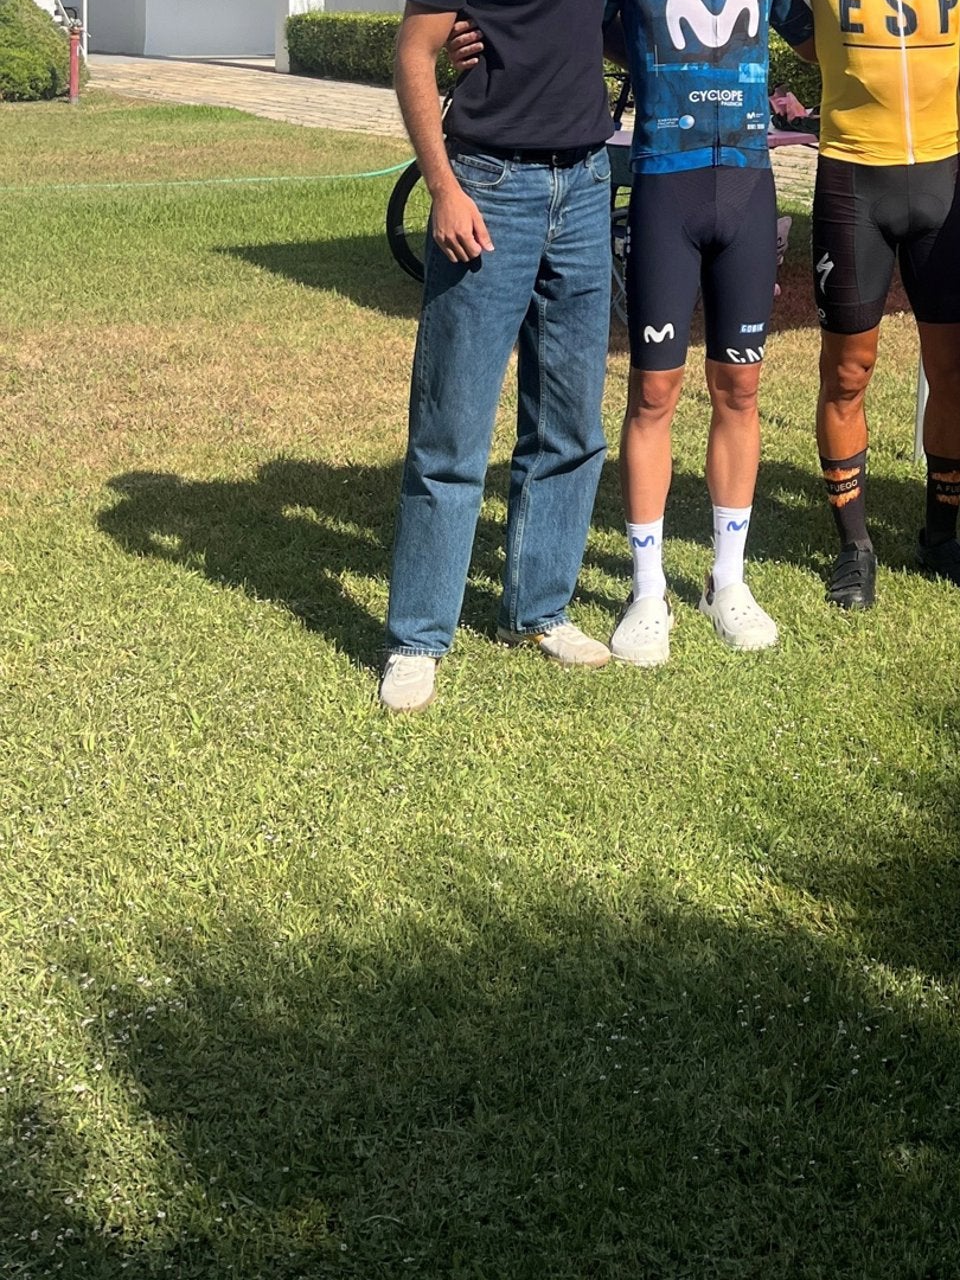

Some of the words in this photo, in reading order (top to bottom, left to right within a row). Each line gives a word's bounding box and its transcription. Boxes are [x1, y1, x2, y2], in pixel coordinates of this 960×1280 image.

[688, 89, 744, 103] CYCLOPE
[739, 322, 765, 333] GOBIK
[830, 479, 858, 493] FUEGO
